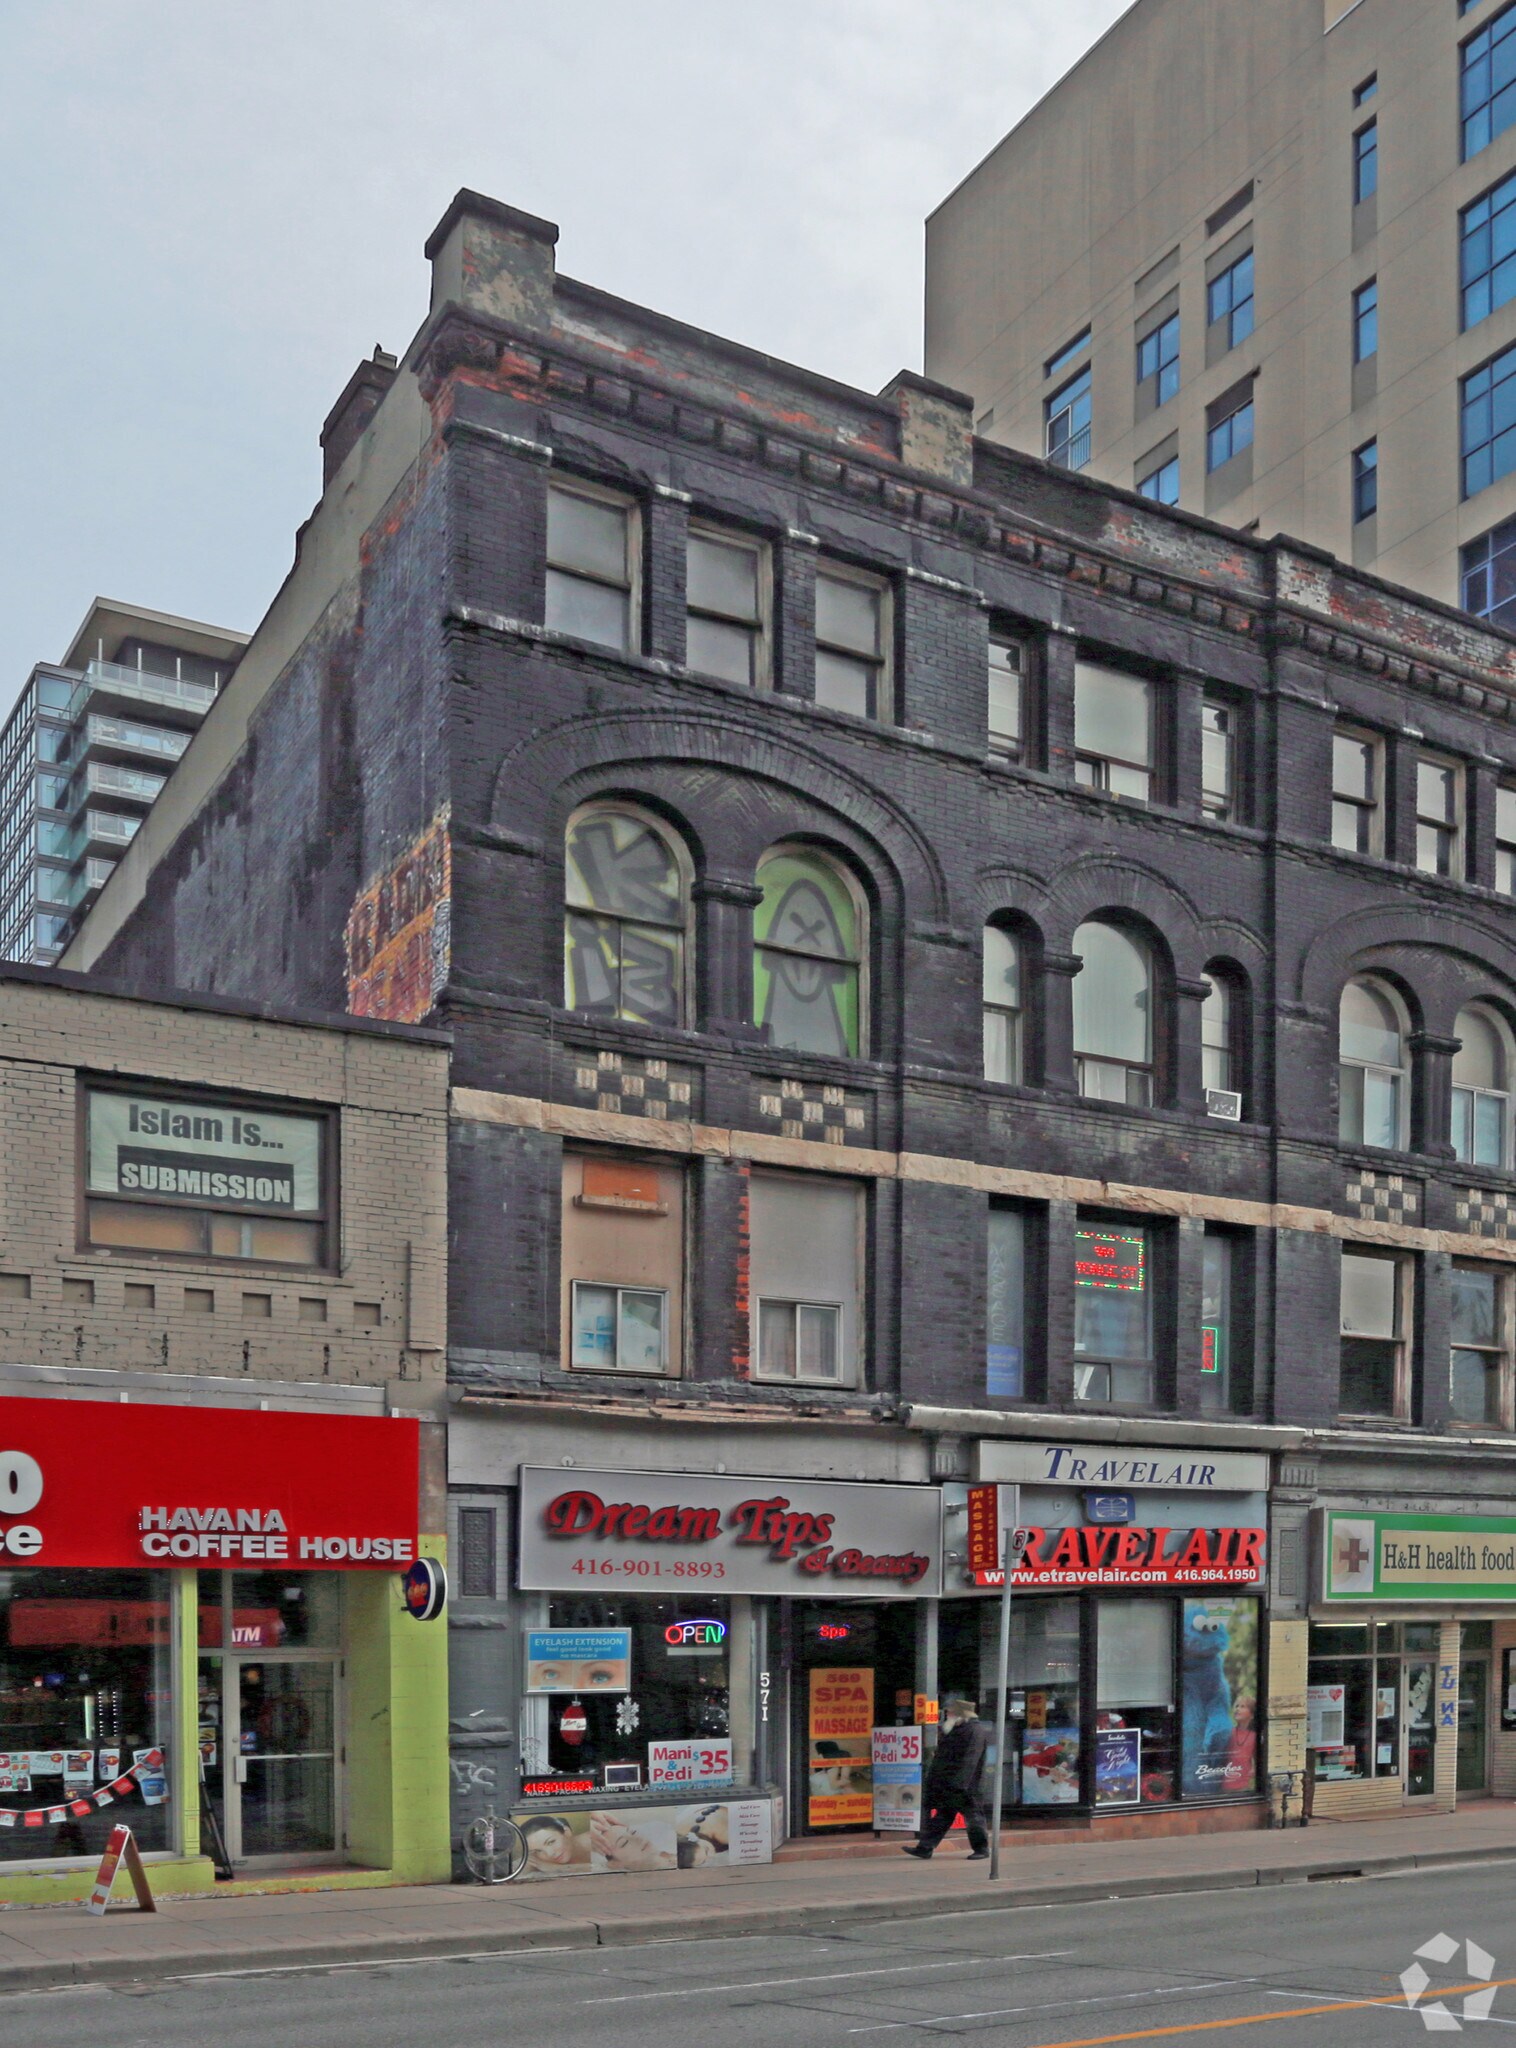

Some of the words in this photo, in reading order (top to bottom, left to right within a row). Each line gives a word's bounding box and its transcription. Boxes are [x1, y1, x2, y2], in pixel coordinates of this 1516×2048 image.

[129, 1103, 223, 1142] Islam
[232, 1116, 284, 1149] Is...
[121, 1162, 291, 1203] SUBMISSION
[1044, 1447, 1216, 1486] TRAVELAIR
[142, 1506, 287, 1532] HAVANA
[548, 1490, 723, 1540] Dream
[736, 1496, 836, 1558] Tips
[971, 1489, 984, 1563] MASSAGE
[0, 1525, 43, 1556] e
[142, 1533, 288, 1559] COFFEE
[300, 1537, 413, 1560] HOUSE
[1019, 1526, 1267, 1568] RAVELAIR
[571, 1558, 726, 1578] 416-901-8893
[803, 1546, 834, 1573] &
[835, 1548, 931, 1584] Beauty
[1384, 1544, 1421, 1569] H&H
[1426, 1545, 1476, 1570] health
[1481, 1546, 1515, 1571] food
[984, 1568, 1167, 1584] www.etravelair.com
[1174, 1569, 1257, 1582] 416.964.1950
[534, 1638, 573, 1646] EYELASH
[575, 1637, 623, 1646] EXTENSION
[665, 1625, 723, 1643] OPEN
[819, 1625, 848, 1639] Spa
[760, 1672, 770, 1721] 571
[815, 1687, 868, 1702] SPA
[815, 1718, 868, 1734] MASSAGE
[874, 1731, 897, 1743] Mani
[653, 1746, 692, 1761] Mani
[692, 1750, 729, 1775] $35
[874, 1750, 897, 1762] Pedi
[653, 1768, 692, 1781] Pedi
[667, 1761, 677, 1770] &
[1195, 1762, 1243, 1776] Beaches
